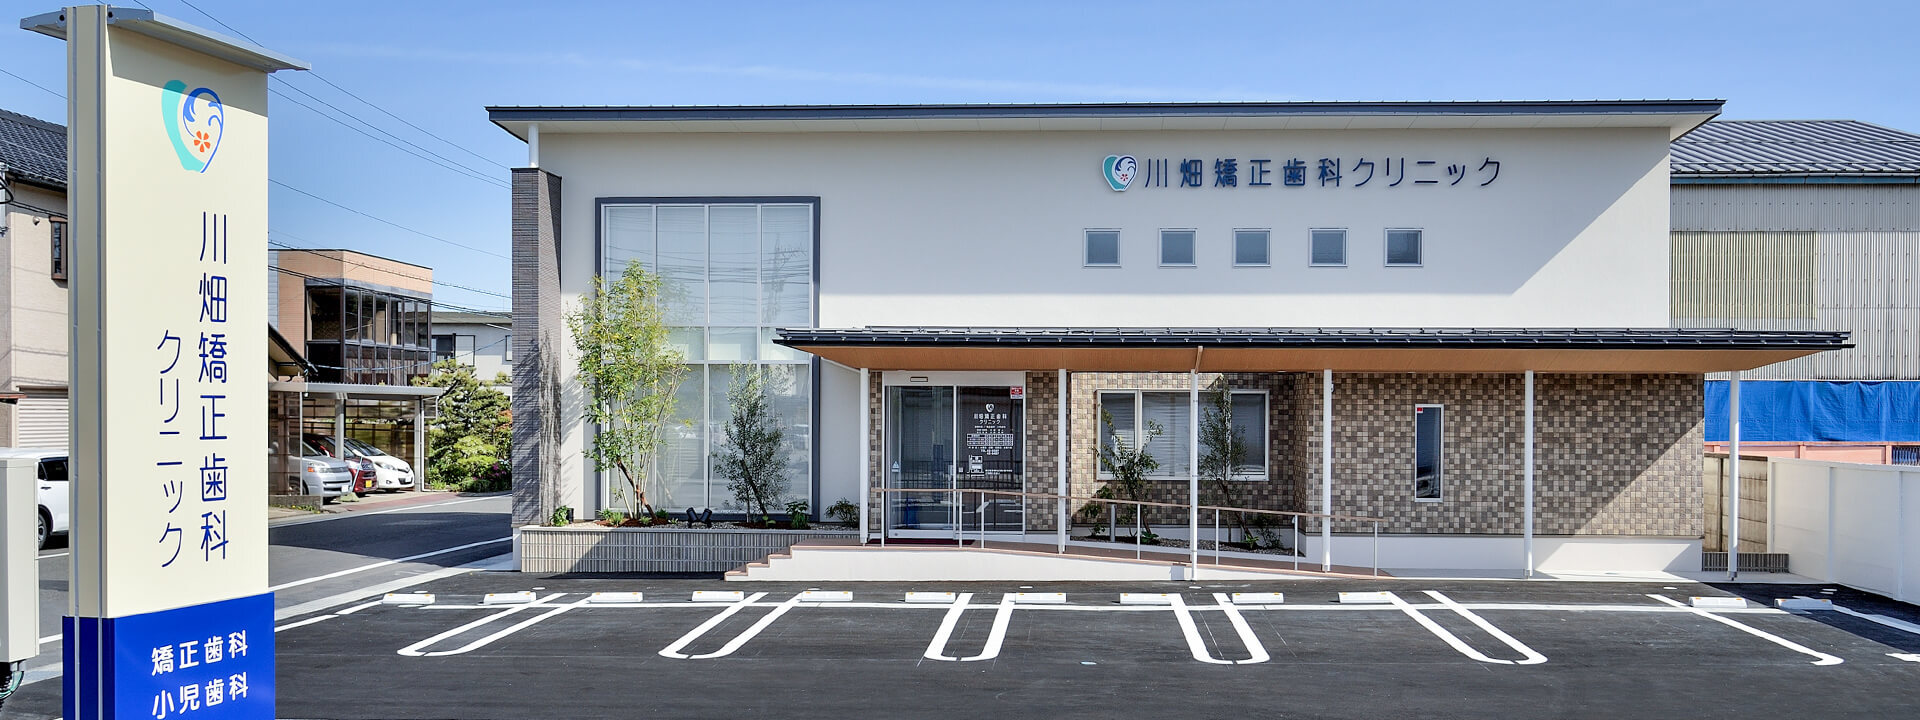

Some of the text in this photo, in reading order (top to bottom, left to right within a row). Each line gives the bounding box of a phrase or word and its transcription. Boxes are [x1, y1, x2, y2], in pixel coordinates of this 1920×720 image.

[1144, 156, 1501, 188] 川畑矯正歯科クリニック
[199, 211, 230, 562] 川畑矯正歯科
[156, 329, 183, 568] クリニック
[151, 629, 248, 677] 矯正歯科
[151, 671, 249, 720] 小児歯科
